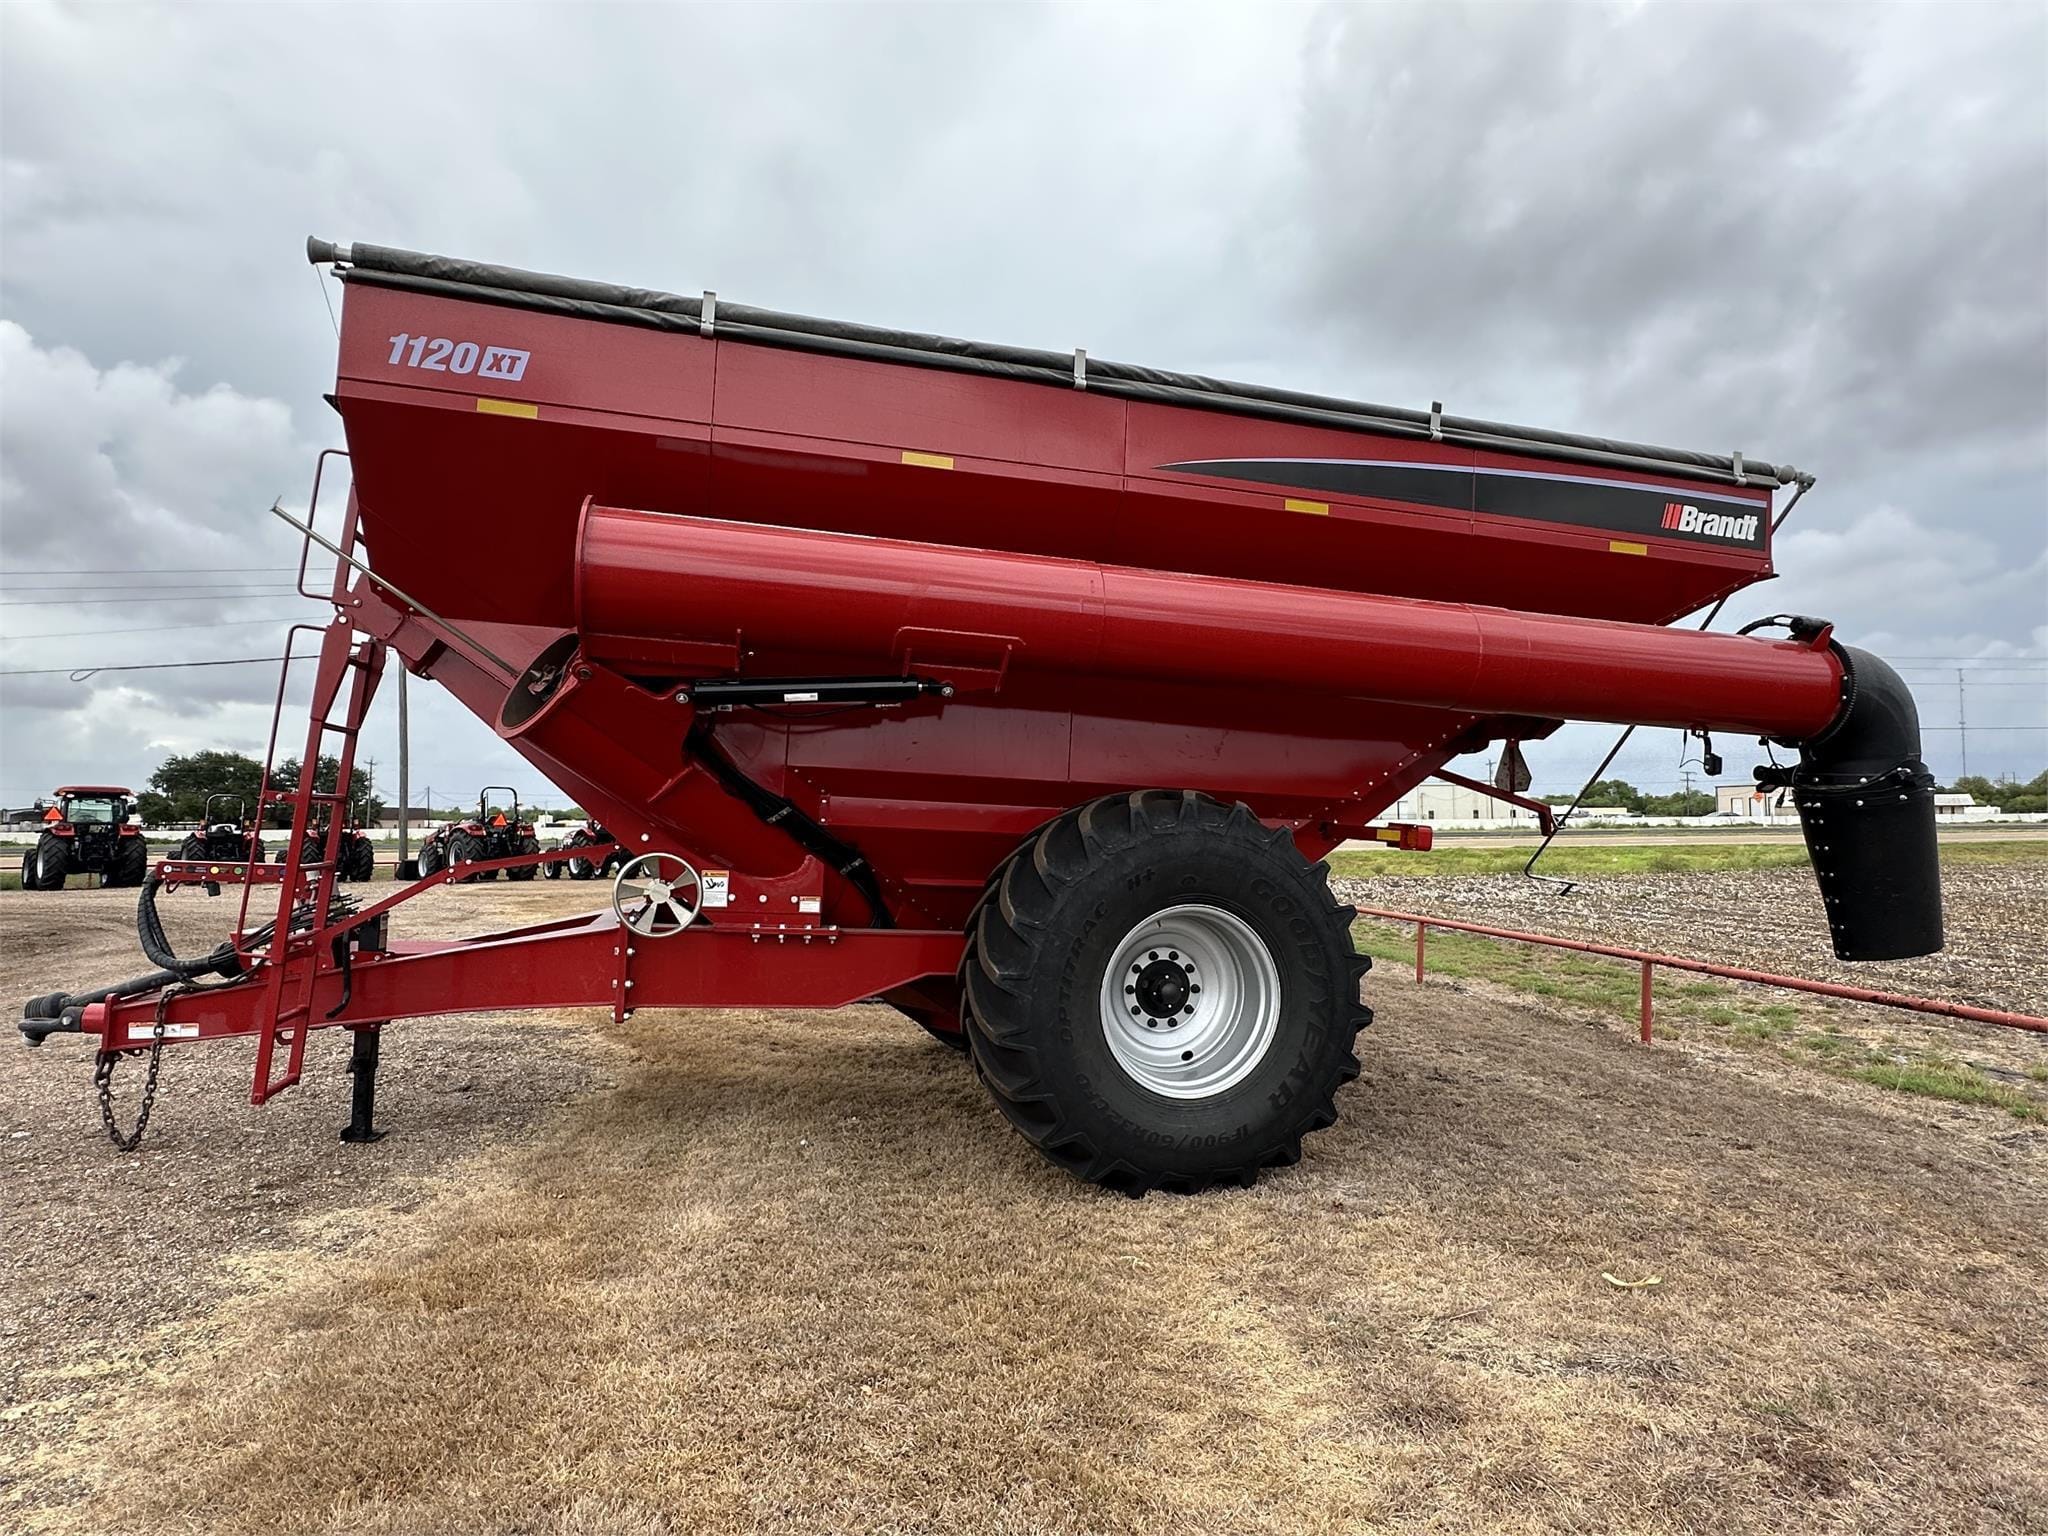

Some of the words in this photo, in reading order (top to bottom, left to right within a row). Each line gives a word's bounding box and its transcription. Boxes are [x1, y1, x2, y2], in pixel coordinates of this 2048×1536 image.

[387, 332, 480, 375] 1120
[484, 350, 523, 375] XT
[1677, 505, 1758, 541] Brandt
[1057, 898, 1110, 1044] OPTITRAC
[1249, 877, 1329, 1111] GOODYEAR
